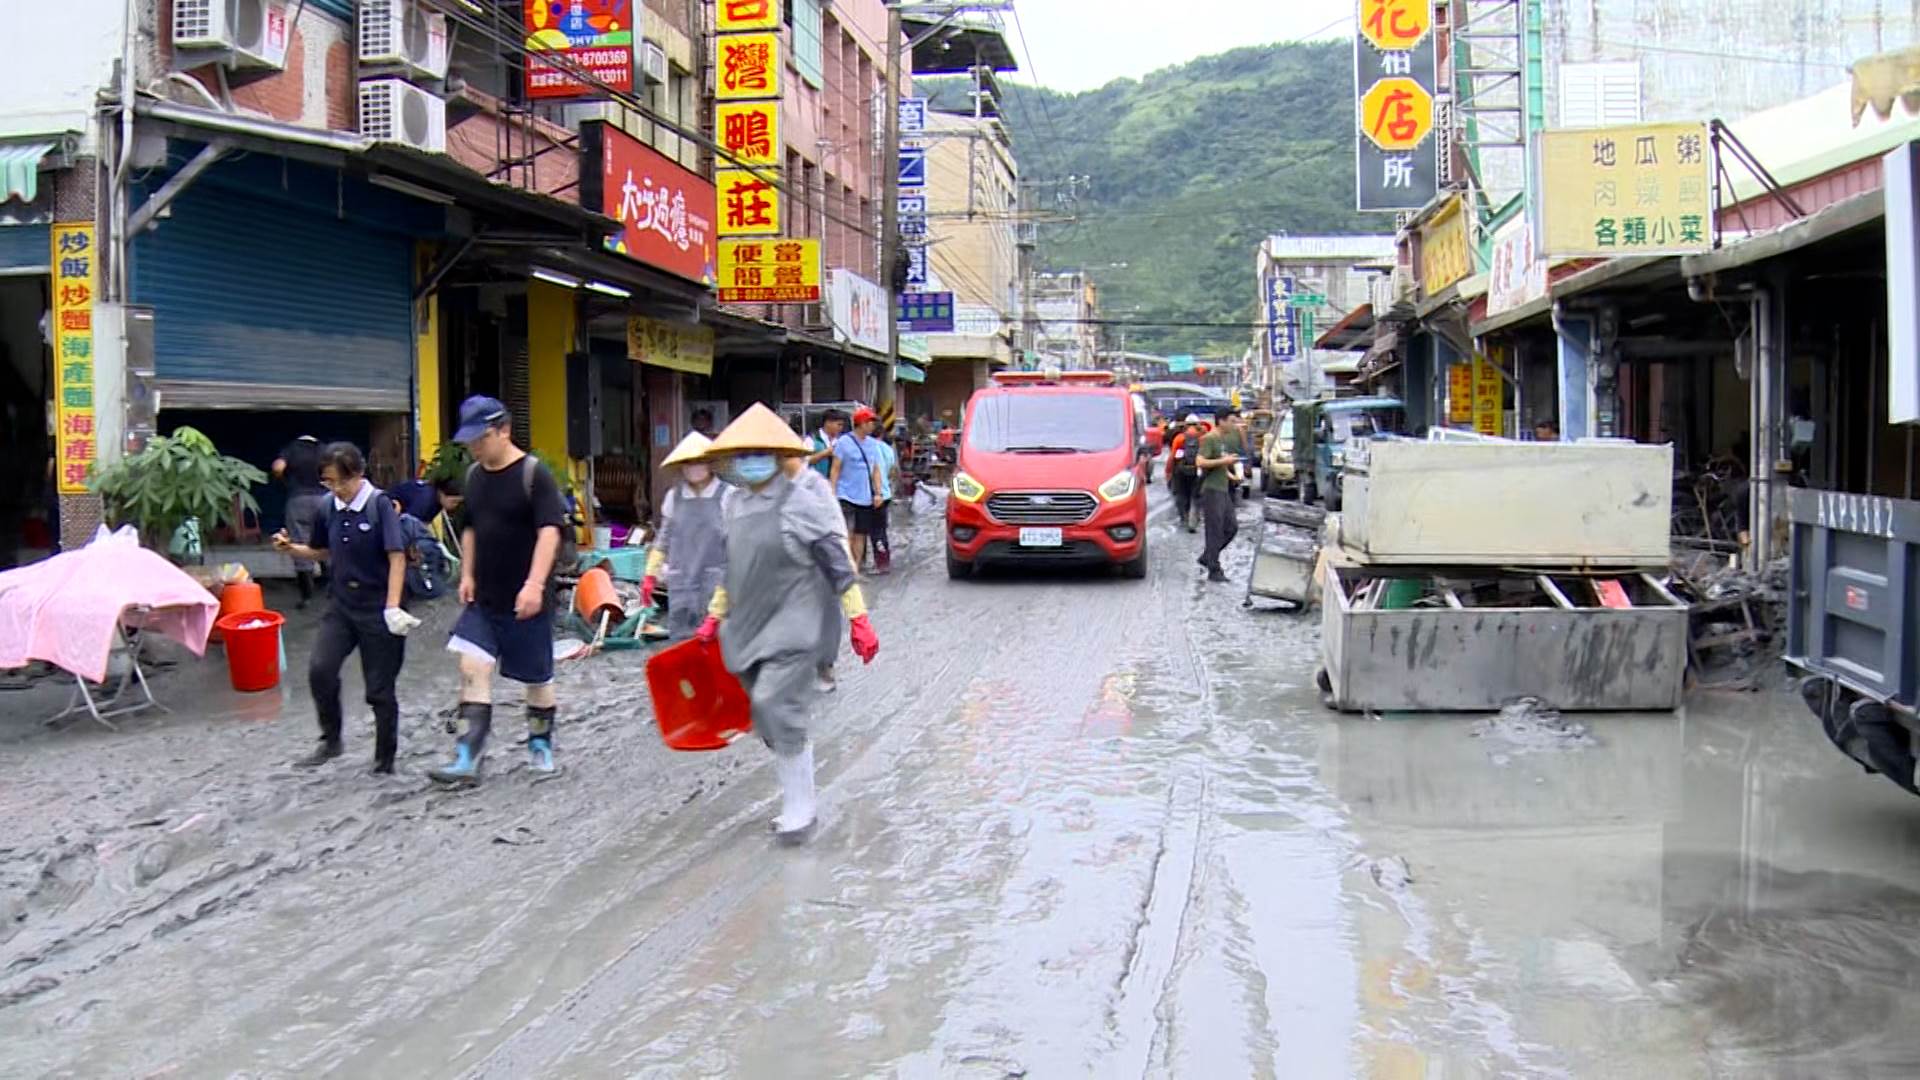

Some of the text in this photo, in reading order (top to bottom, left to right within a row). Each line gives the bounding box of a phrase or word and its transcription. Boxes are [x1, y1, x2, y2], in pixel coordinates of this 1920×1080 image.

[1593, 135, 1702, 167] 地瓜粥
[1594, 214, 1704, 247] 各類小菜
[733, 243, 803, 263] 便當
